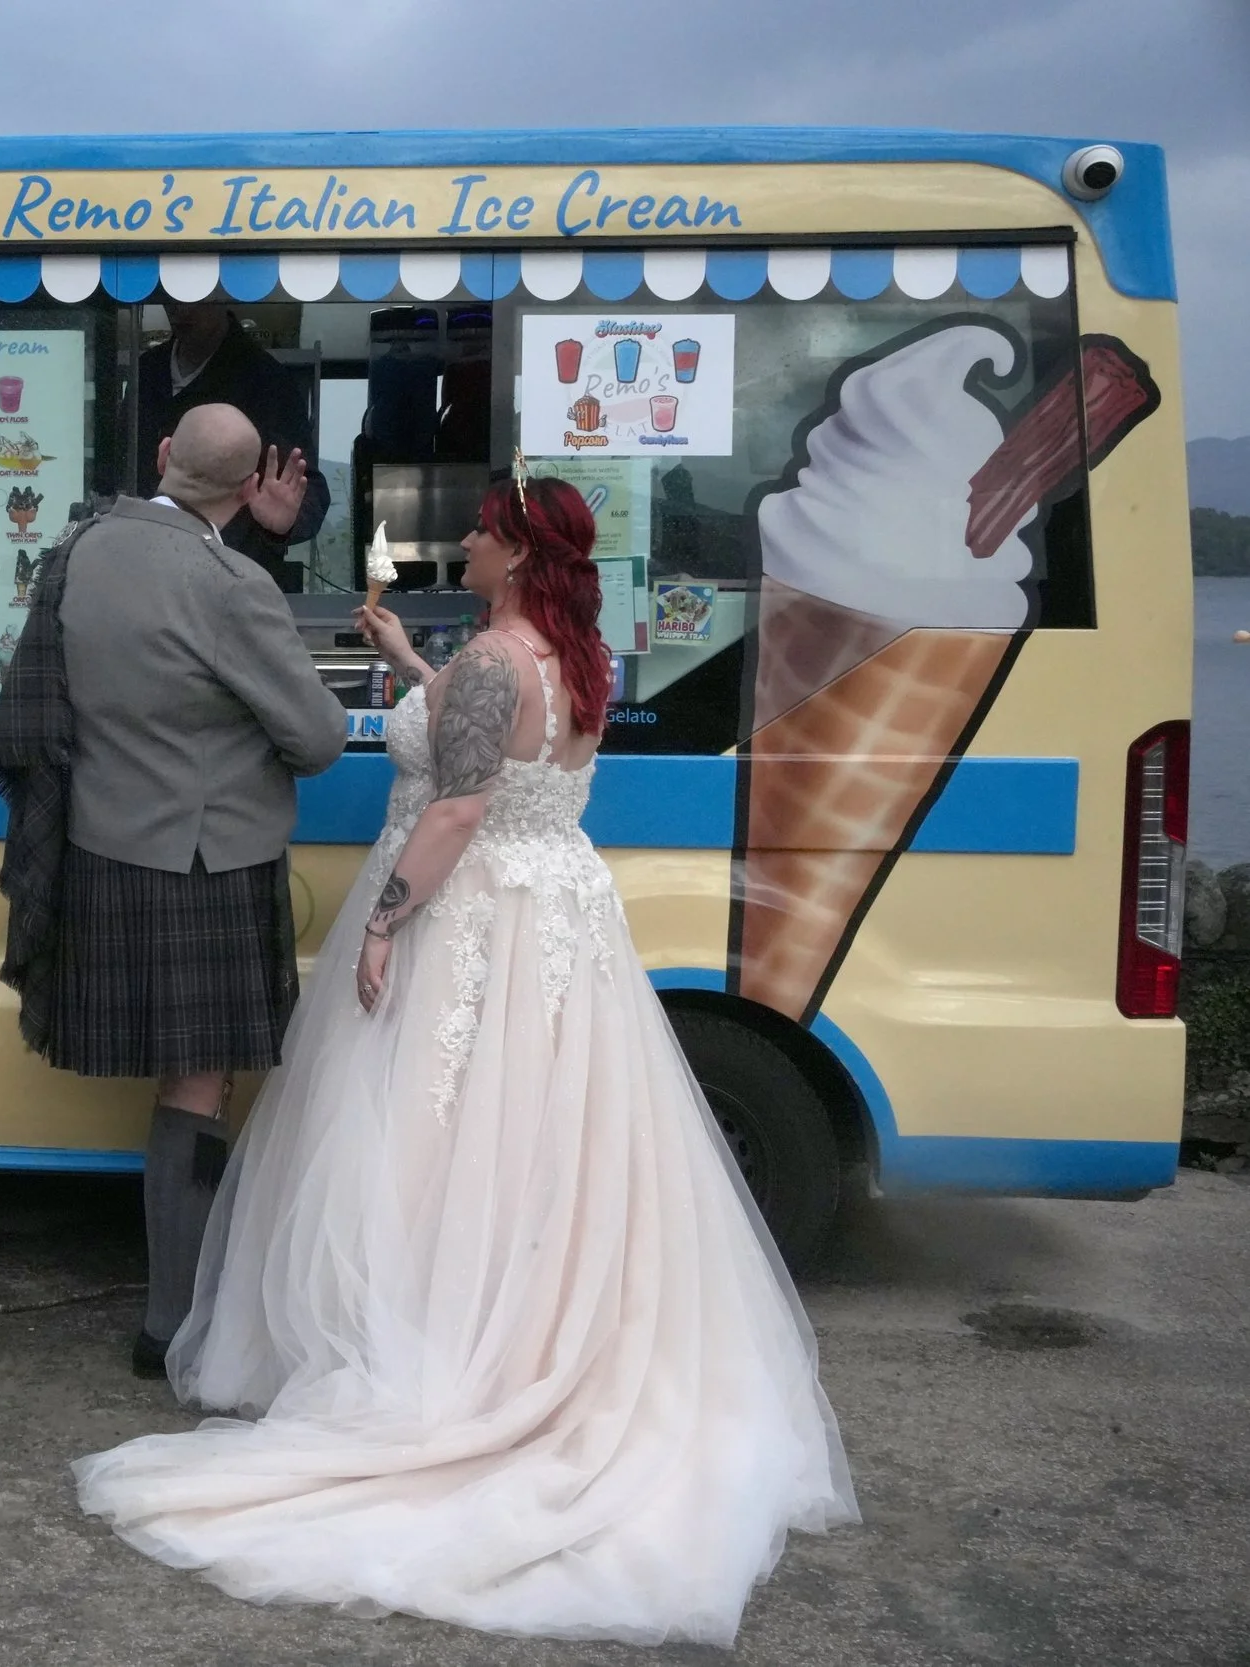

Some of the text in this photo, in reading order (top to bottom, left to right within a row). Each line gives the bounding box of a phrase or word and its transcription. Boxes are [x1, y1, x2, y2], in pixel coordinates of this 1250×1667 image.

[3, 170, 742, 239] Remo's Italian Ice Cream
[584, 367, 670, 398] Remo's
[564, 431, 609, 450] Popcorn
[658, 621, 695, 631] HARIBO
[689, 633, 710, 641] TRAY
[604, 708, 657, 724] Gelato
